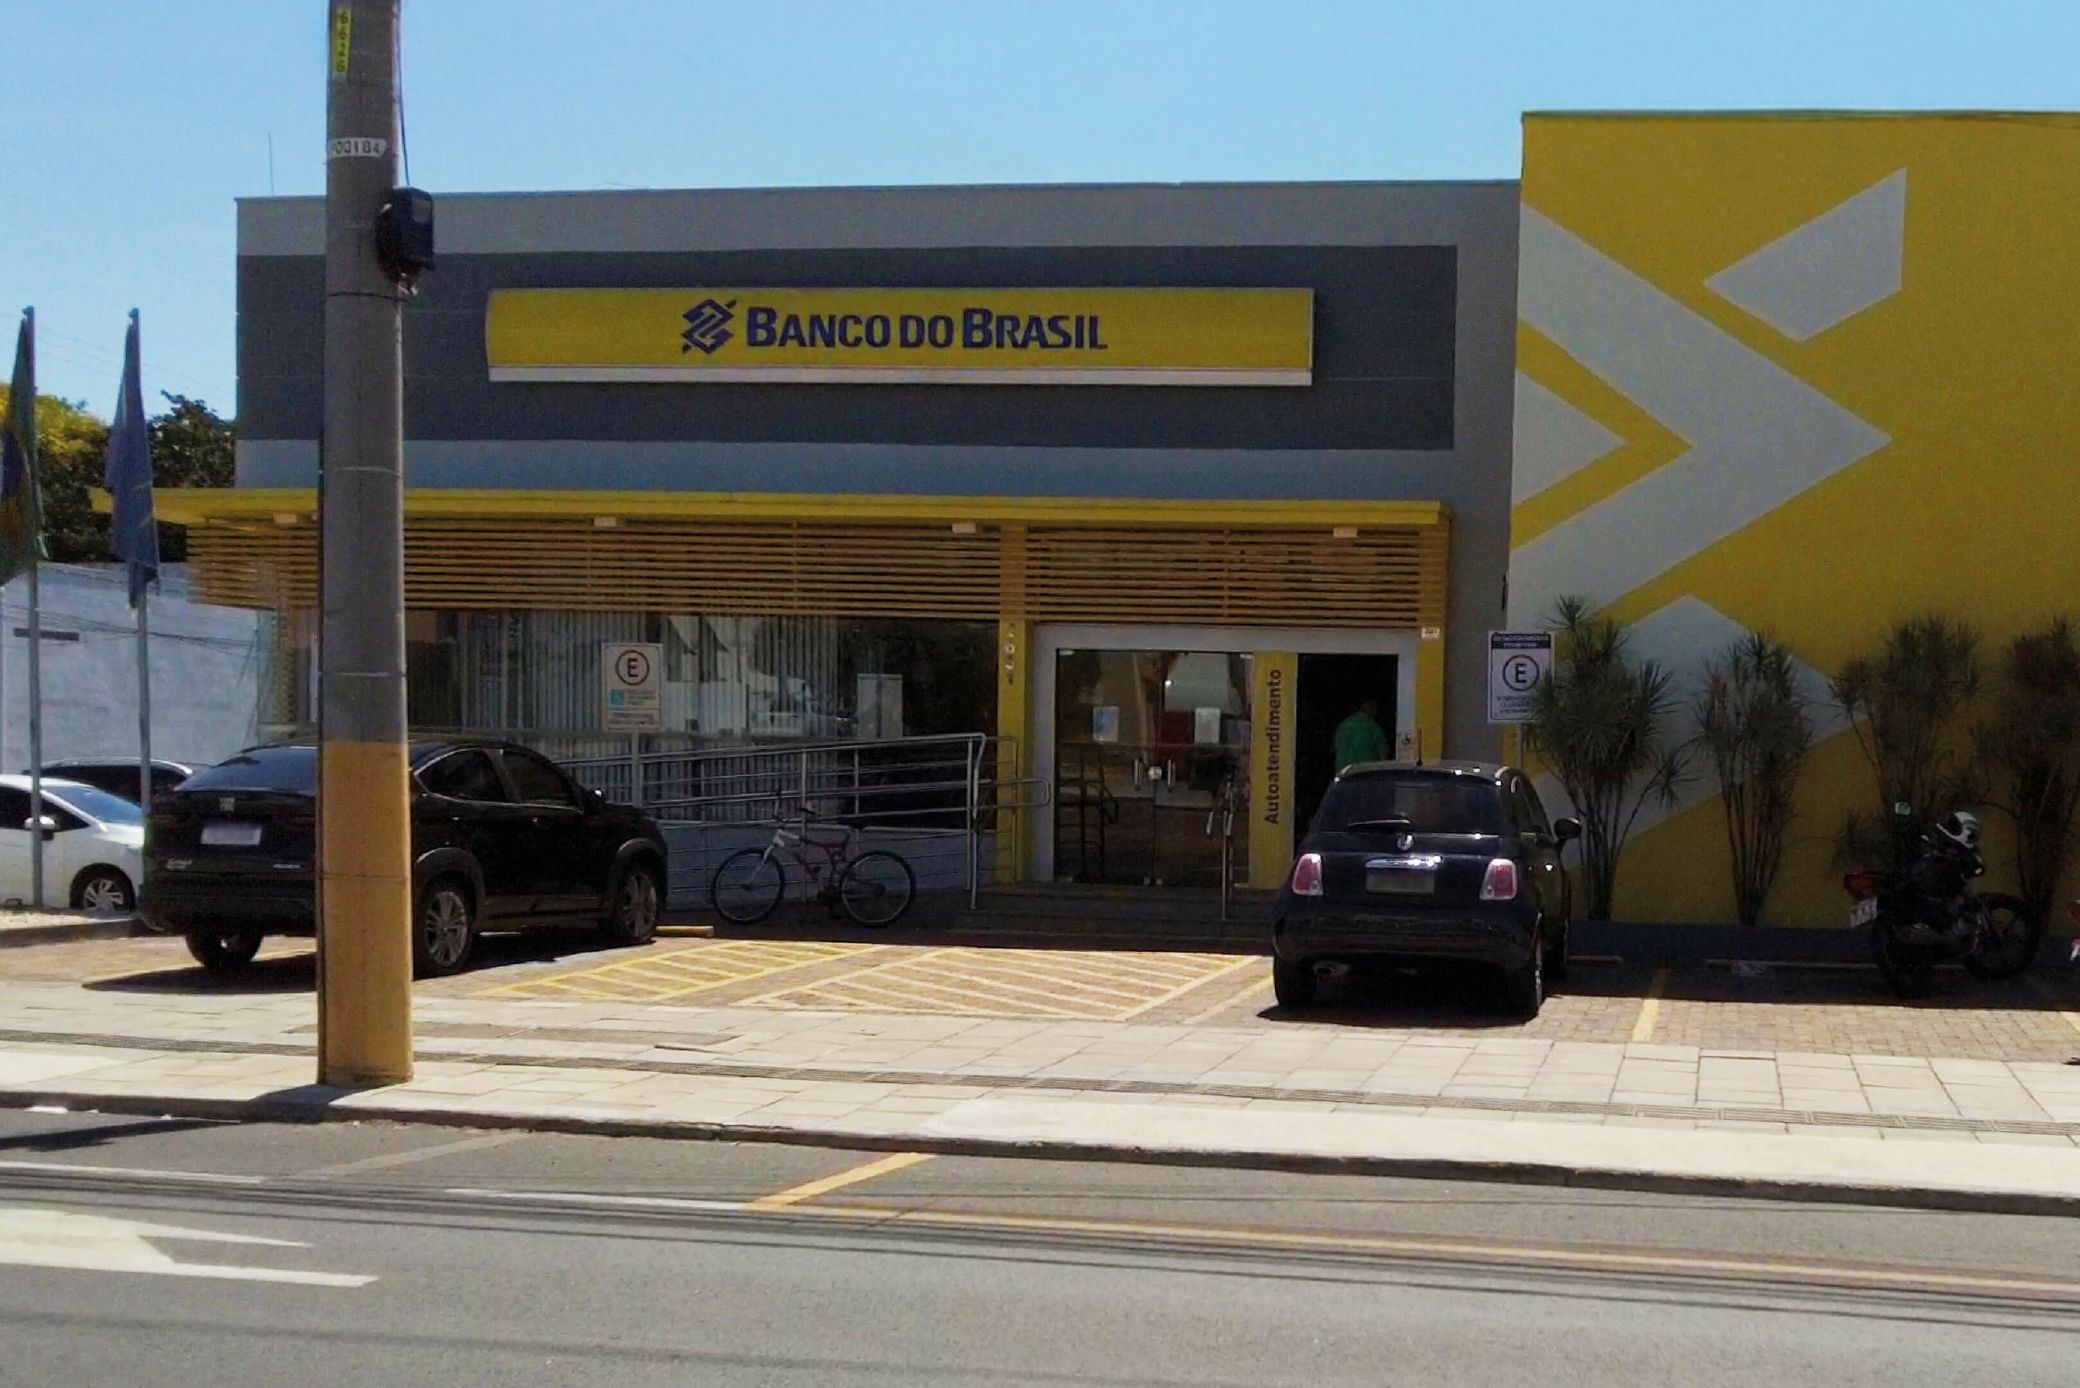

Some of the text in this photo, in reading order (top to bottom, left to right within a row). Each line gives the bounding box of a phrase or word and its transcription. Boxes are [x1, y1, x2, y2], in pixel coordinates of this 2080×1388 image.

[747, 306, 1108, 349] BANCO DO BRASIL
[627, 658, 638, 677] E
[1515, 663, 1527, 683] E
[1264, 669, 1282, 825] Autoatendimento
